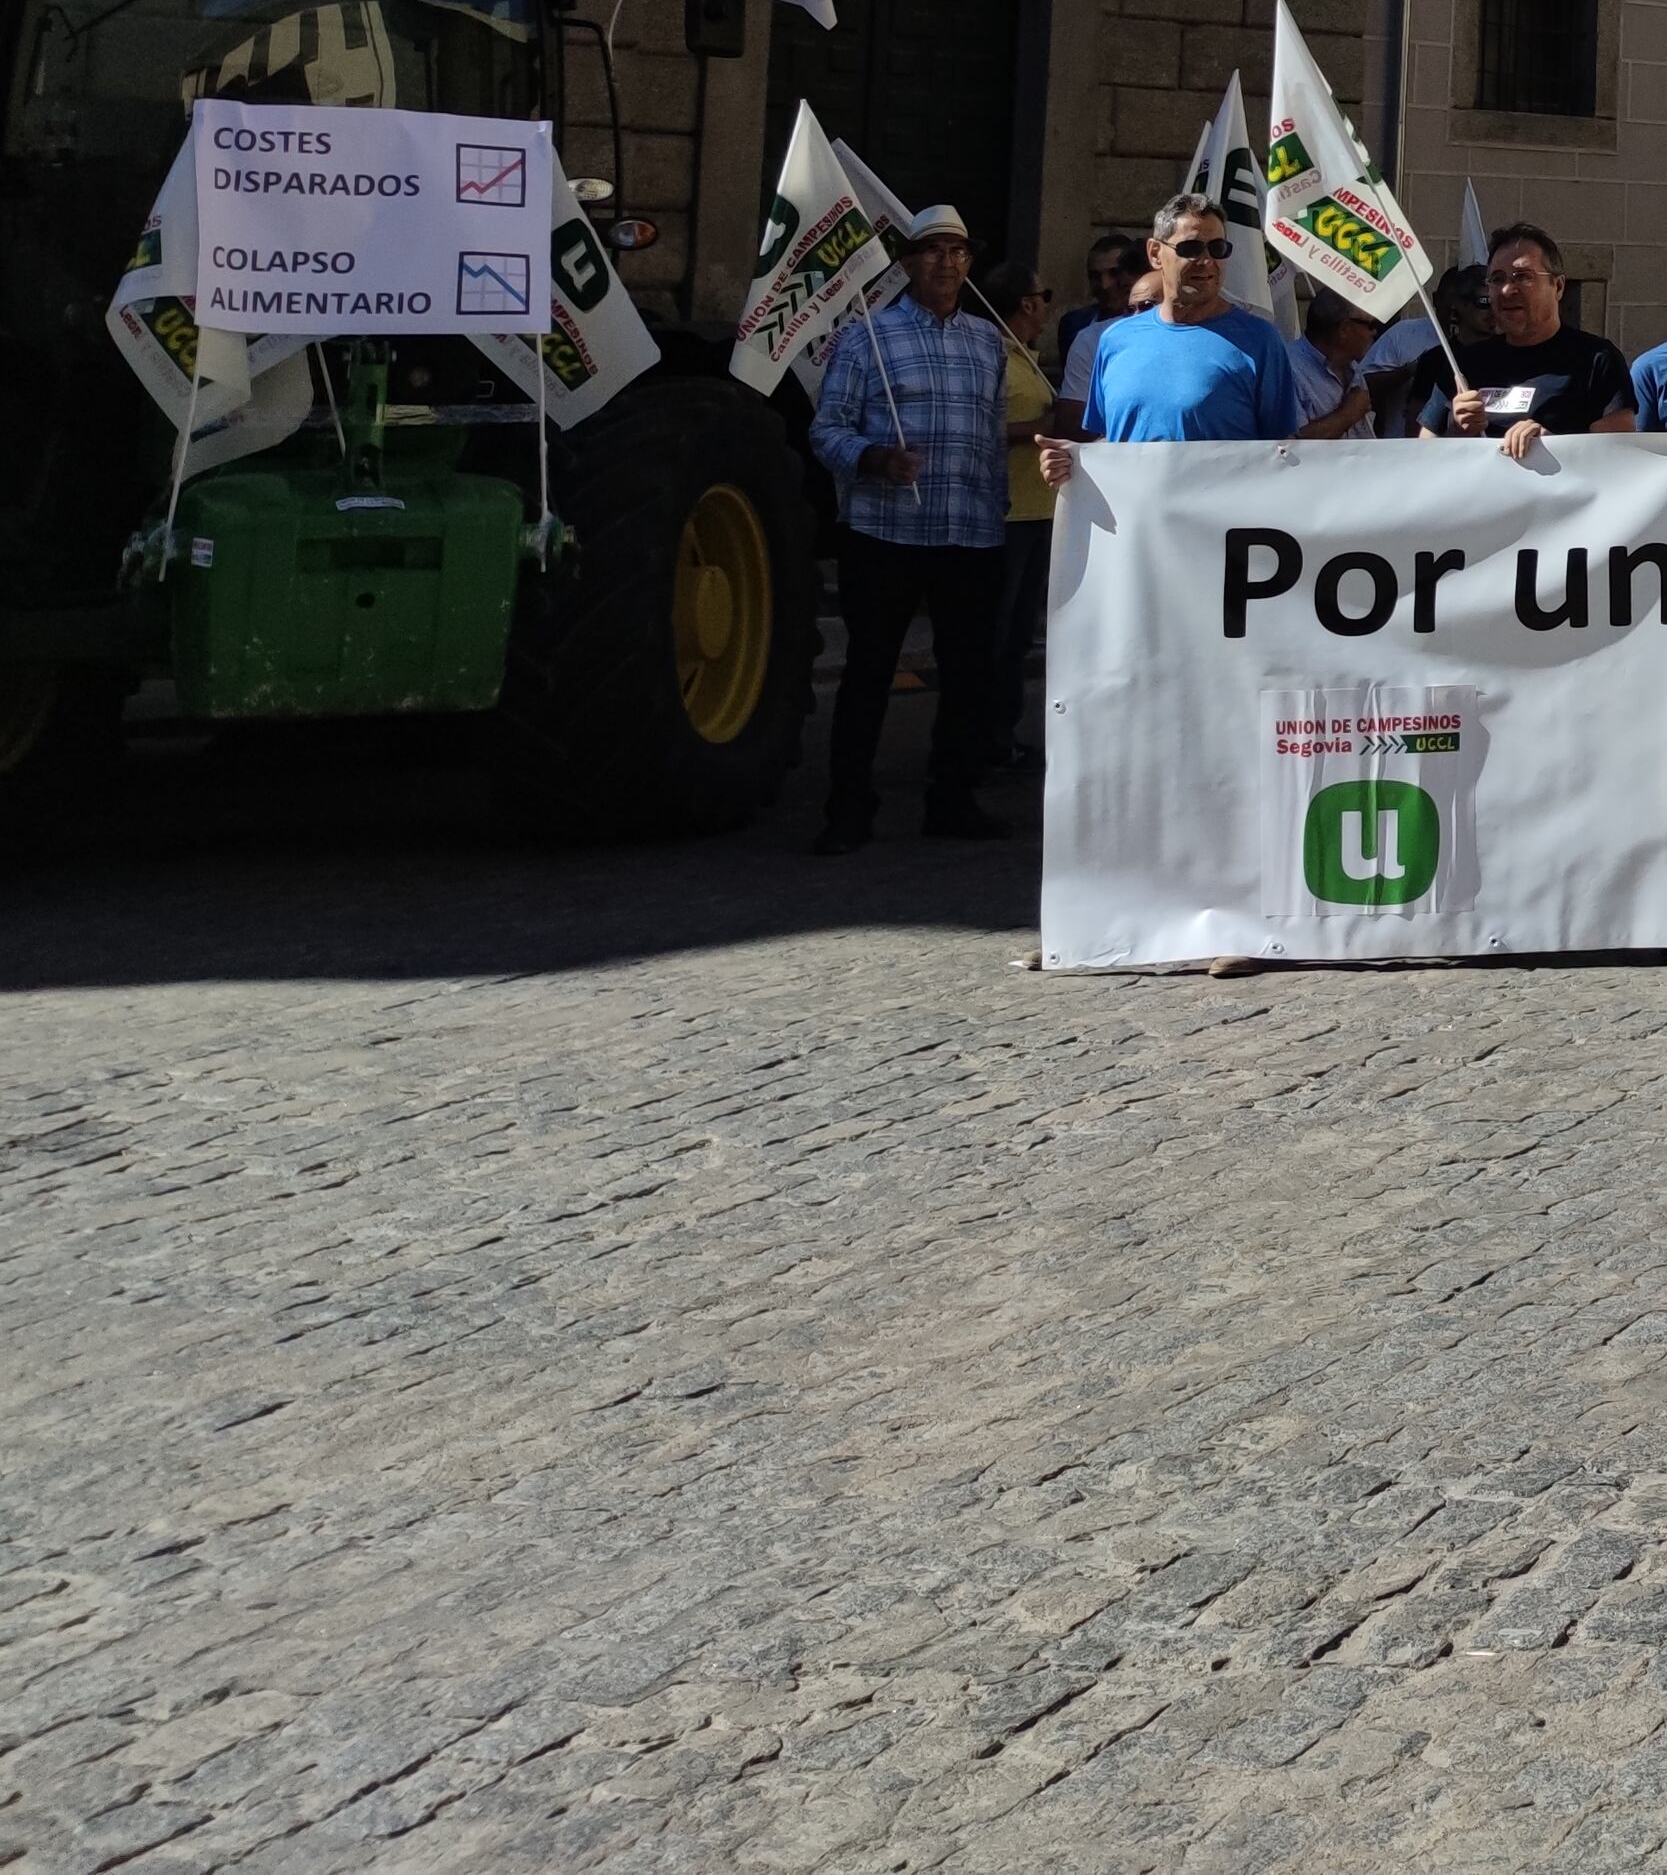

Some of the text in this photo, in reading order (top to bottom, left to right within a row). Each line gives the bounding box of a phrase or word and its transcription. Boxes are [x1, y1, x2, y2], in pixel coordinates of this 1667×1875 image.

[213, 127, 332, 155] COSTES
[213, 167, 420, 197] DISPARADOS
[212, 246, 356, 275] COLAPSO
[816, 221, 871, 267] UCCL
[735, 196, 854, 342] UNION DE CAMPESINOS
[210, 287, 432, 315] ALIMENTARIO
[770, 313, 811, 363] Castilla
[809, 301, 822, 315] y
[811, 323, 849, 368] Castilla
[1223, 527, 1465, 638] Por
[1276, 714, 1462, 736] UNION DE CAMPESINOS
[1276, 737, 1456, 758] Segovia UCCL
[1340, 809, 1406, 881] u
